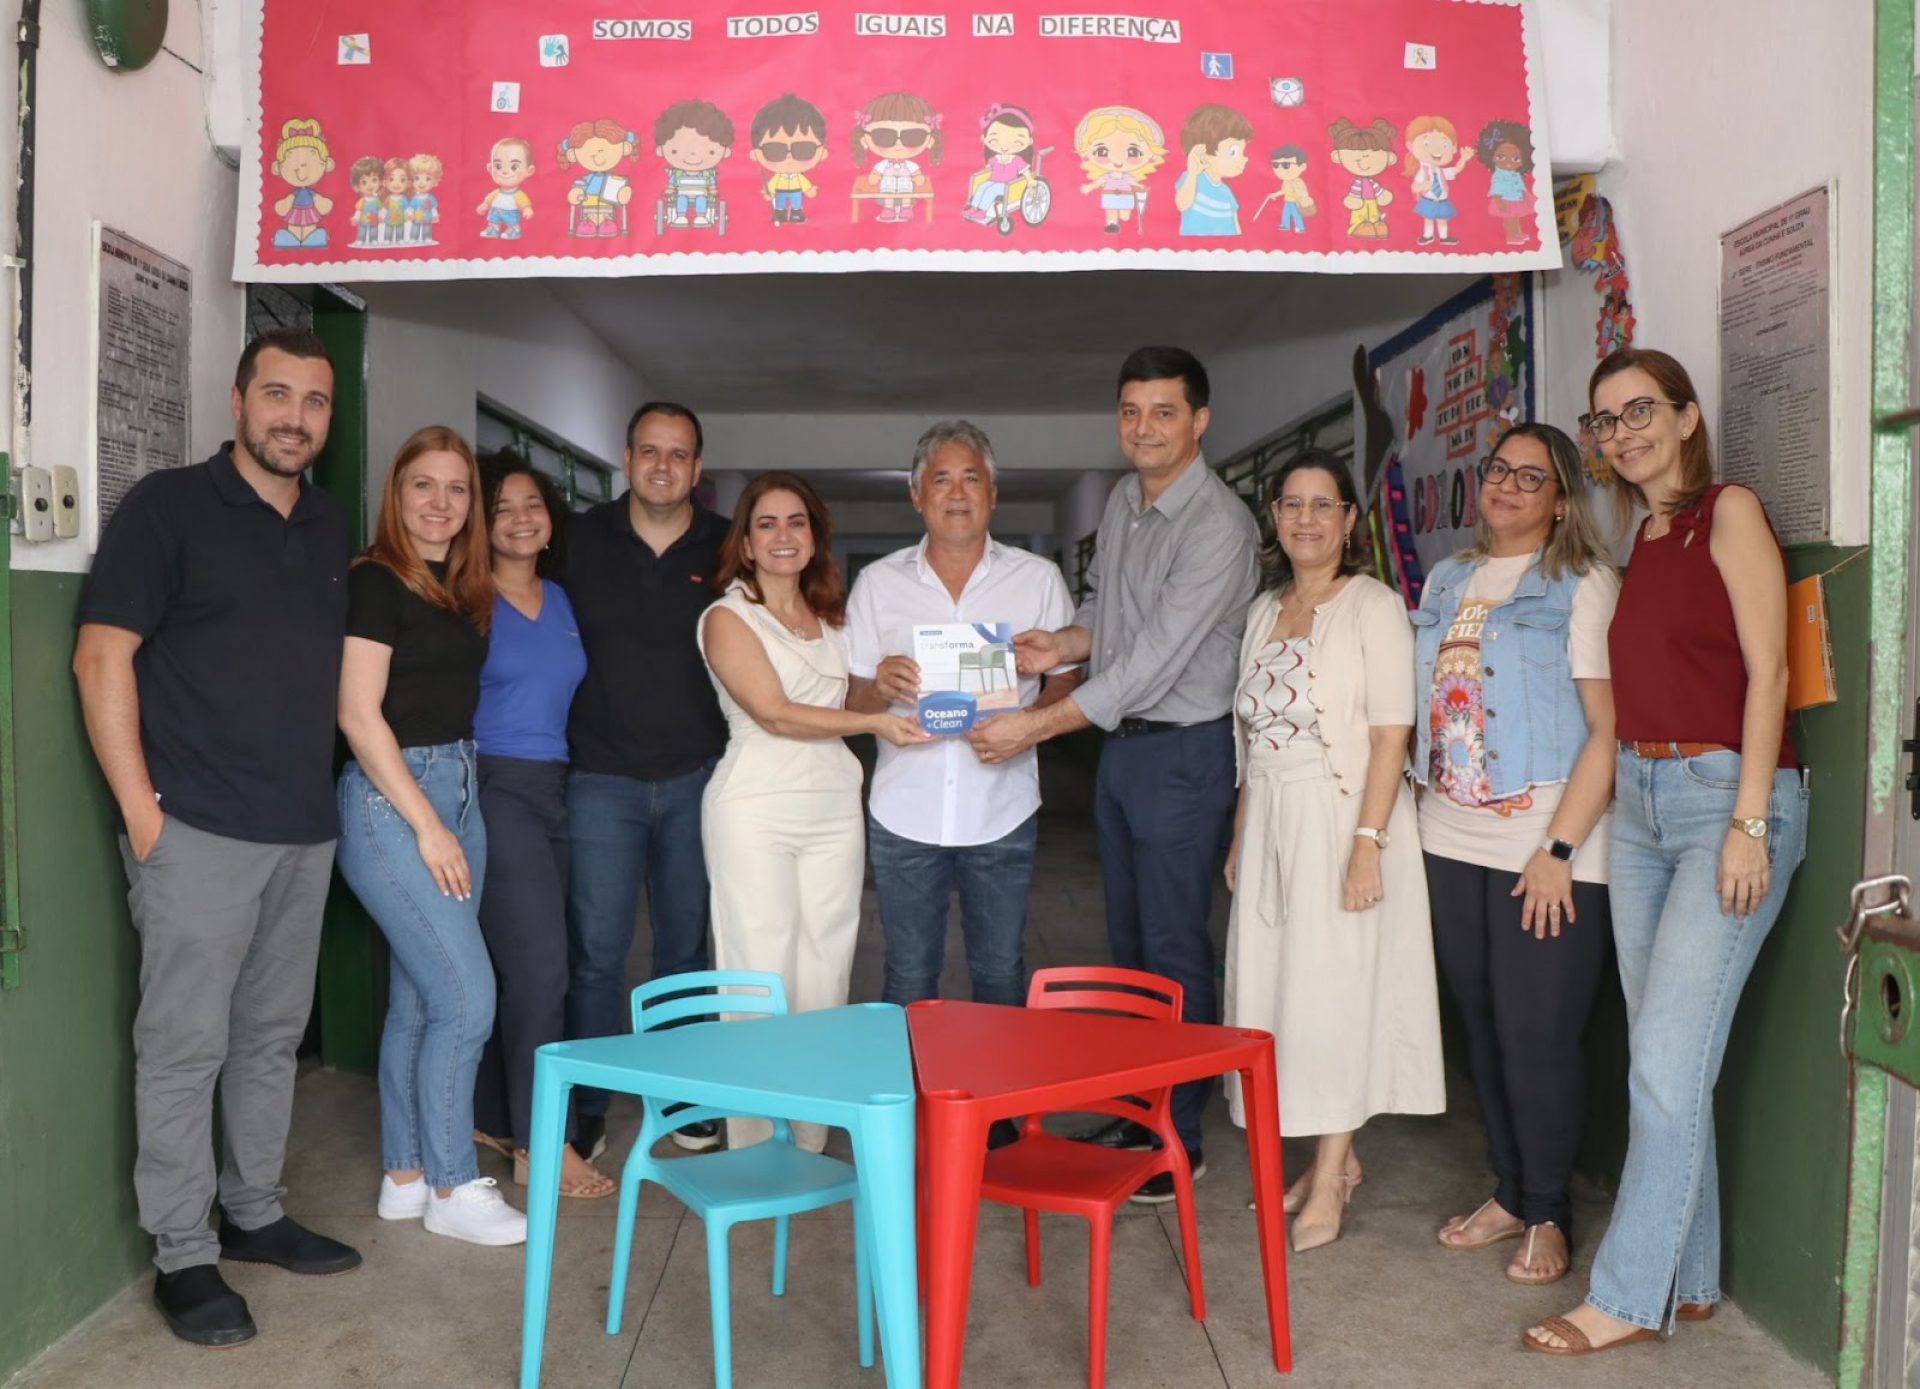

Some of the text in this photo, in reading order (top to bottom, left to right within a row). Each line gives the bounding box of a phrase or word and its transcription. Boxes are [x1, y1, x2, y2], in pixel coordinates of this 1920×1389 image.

[594, 13, 1178, 41] SOMOS TODOS IGUAIS NA DIFERENÇA
[924, 709, 968, 719] Oceano
